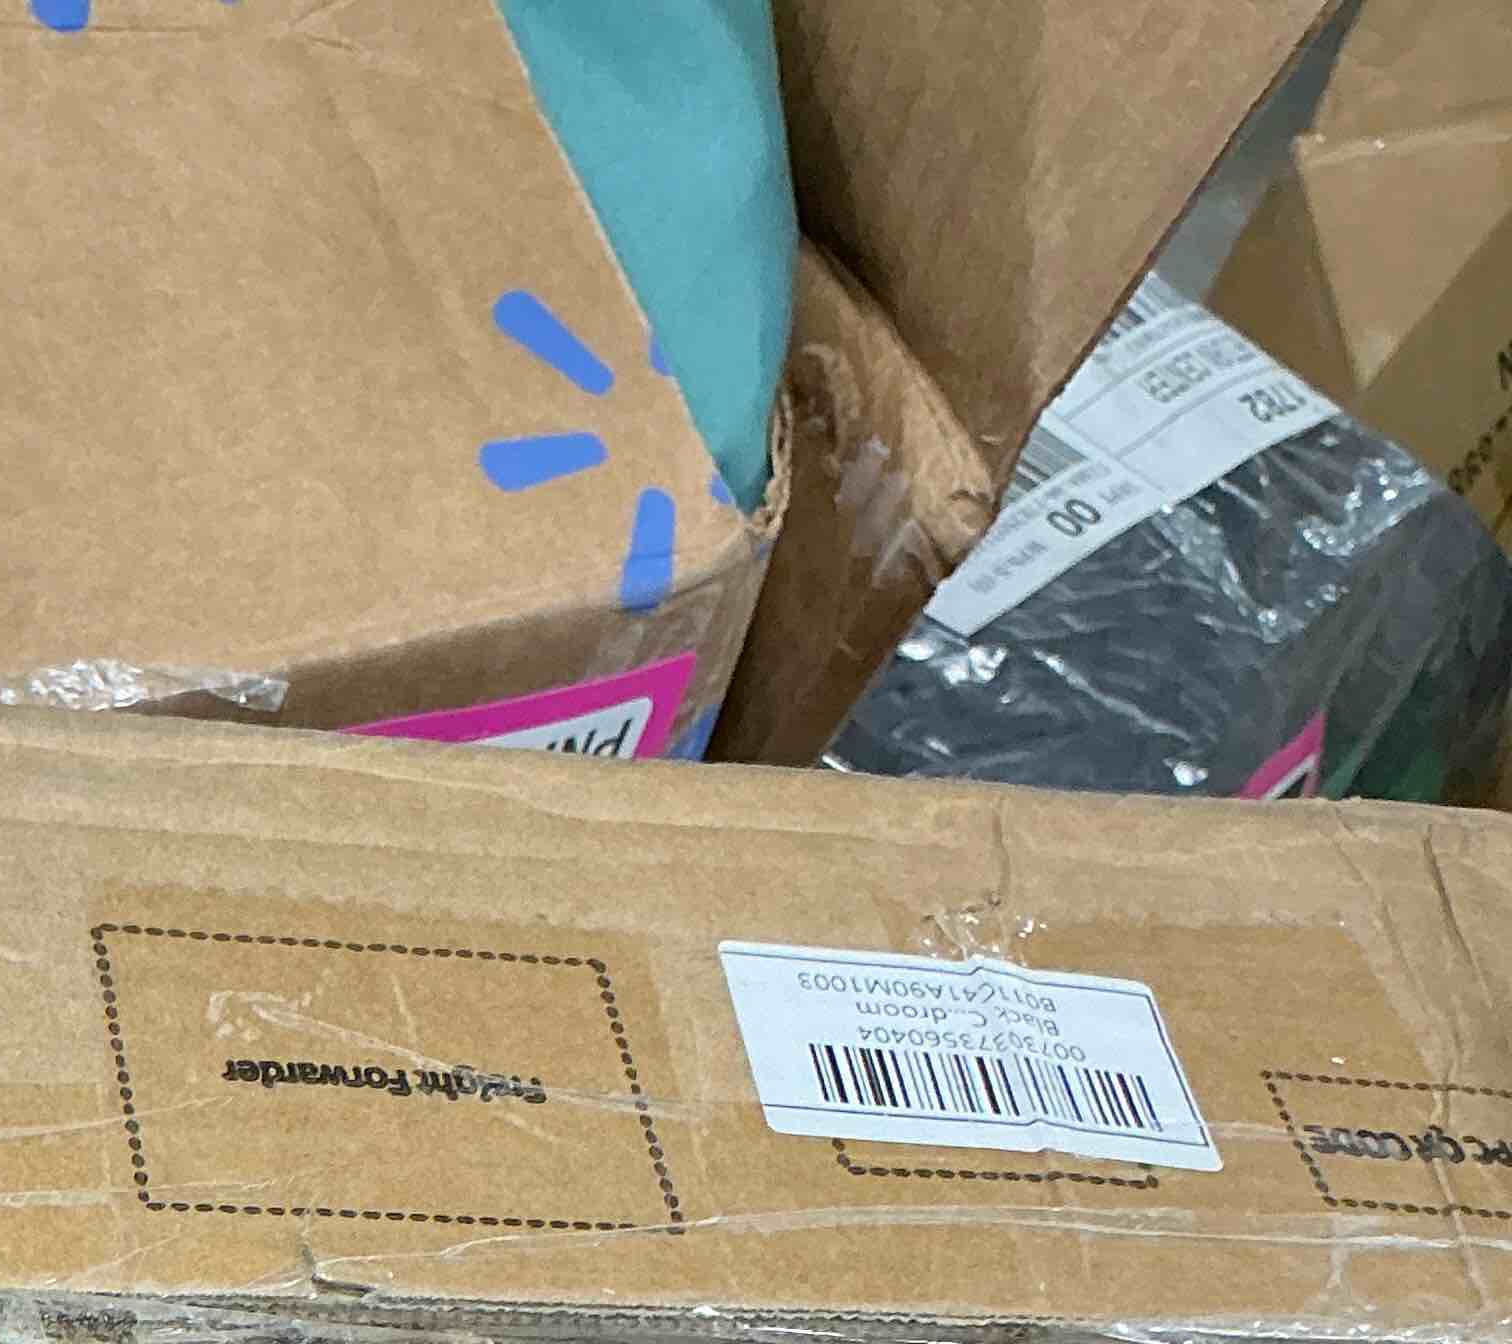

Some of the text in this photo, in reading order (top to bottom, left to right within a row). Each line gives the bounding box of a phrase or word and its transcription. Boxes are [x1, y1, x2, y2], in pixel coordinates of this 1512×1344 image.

[1046, 499, 1101, 537] 00
[994, 1005, 1058, 1037] Black
[221, 1057, 413, 1098] Forwarder
